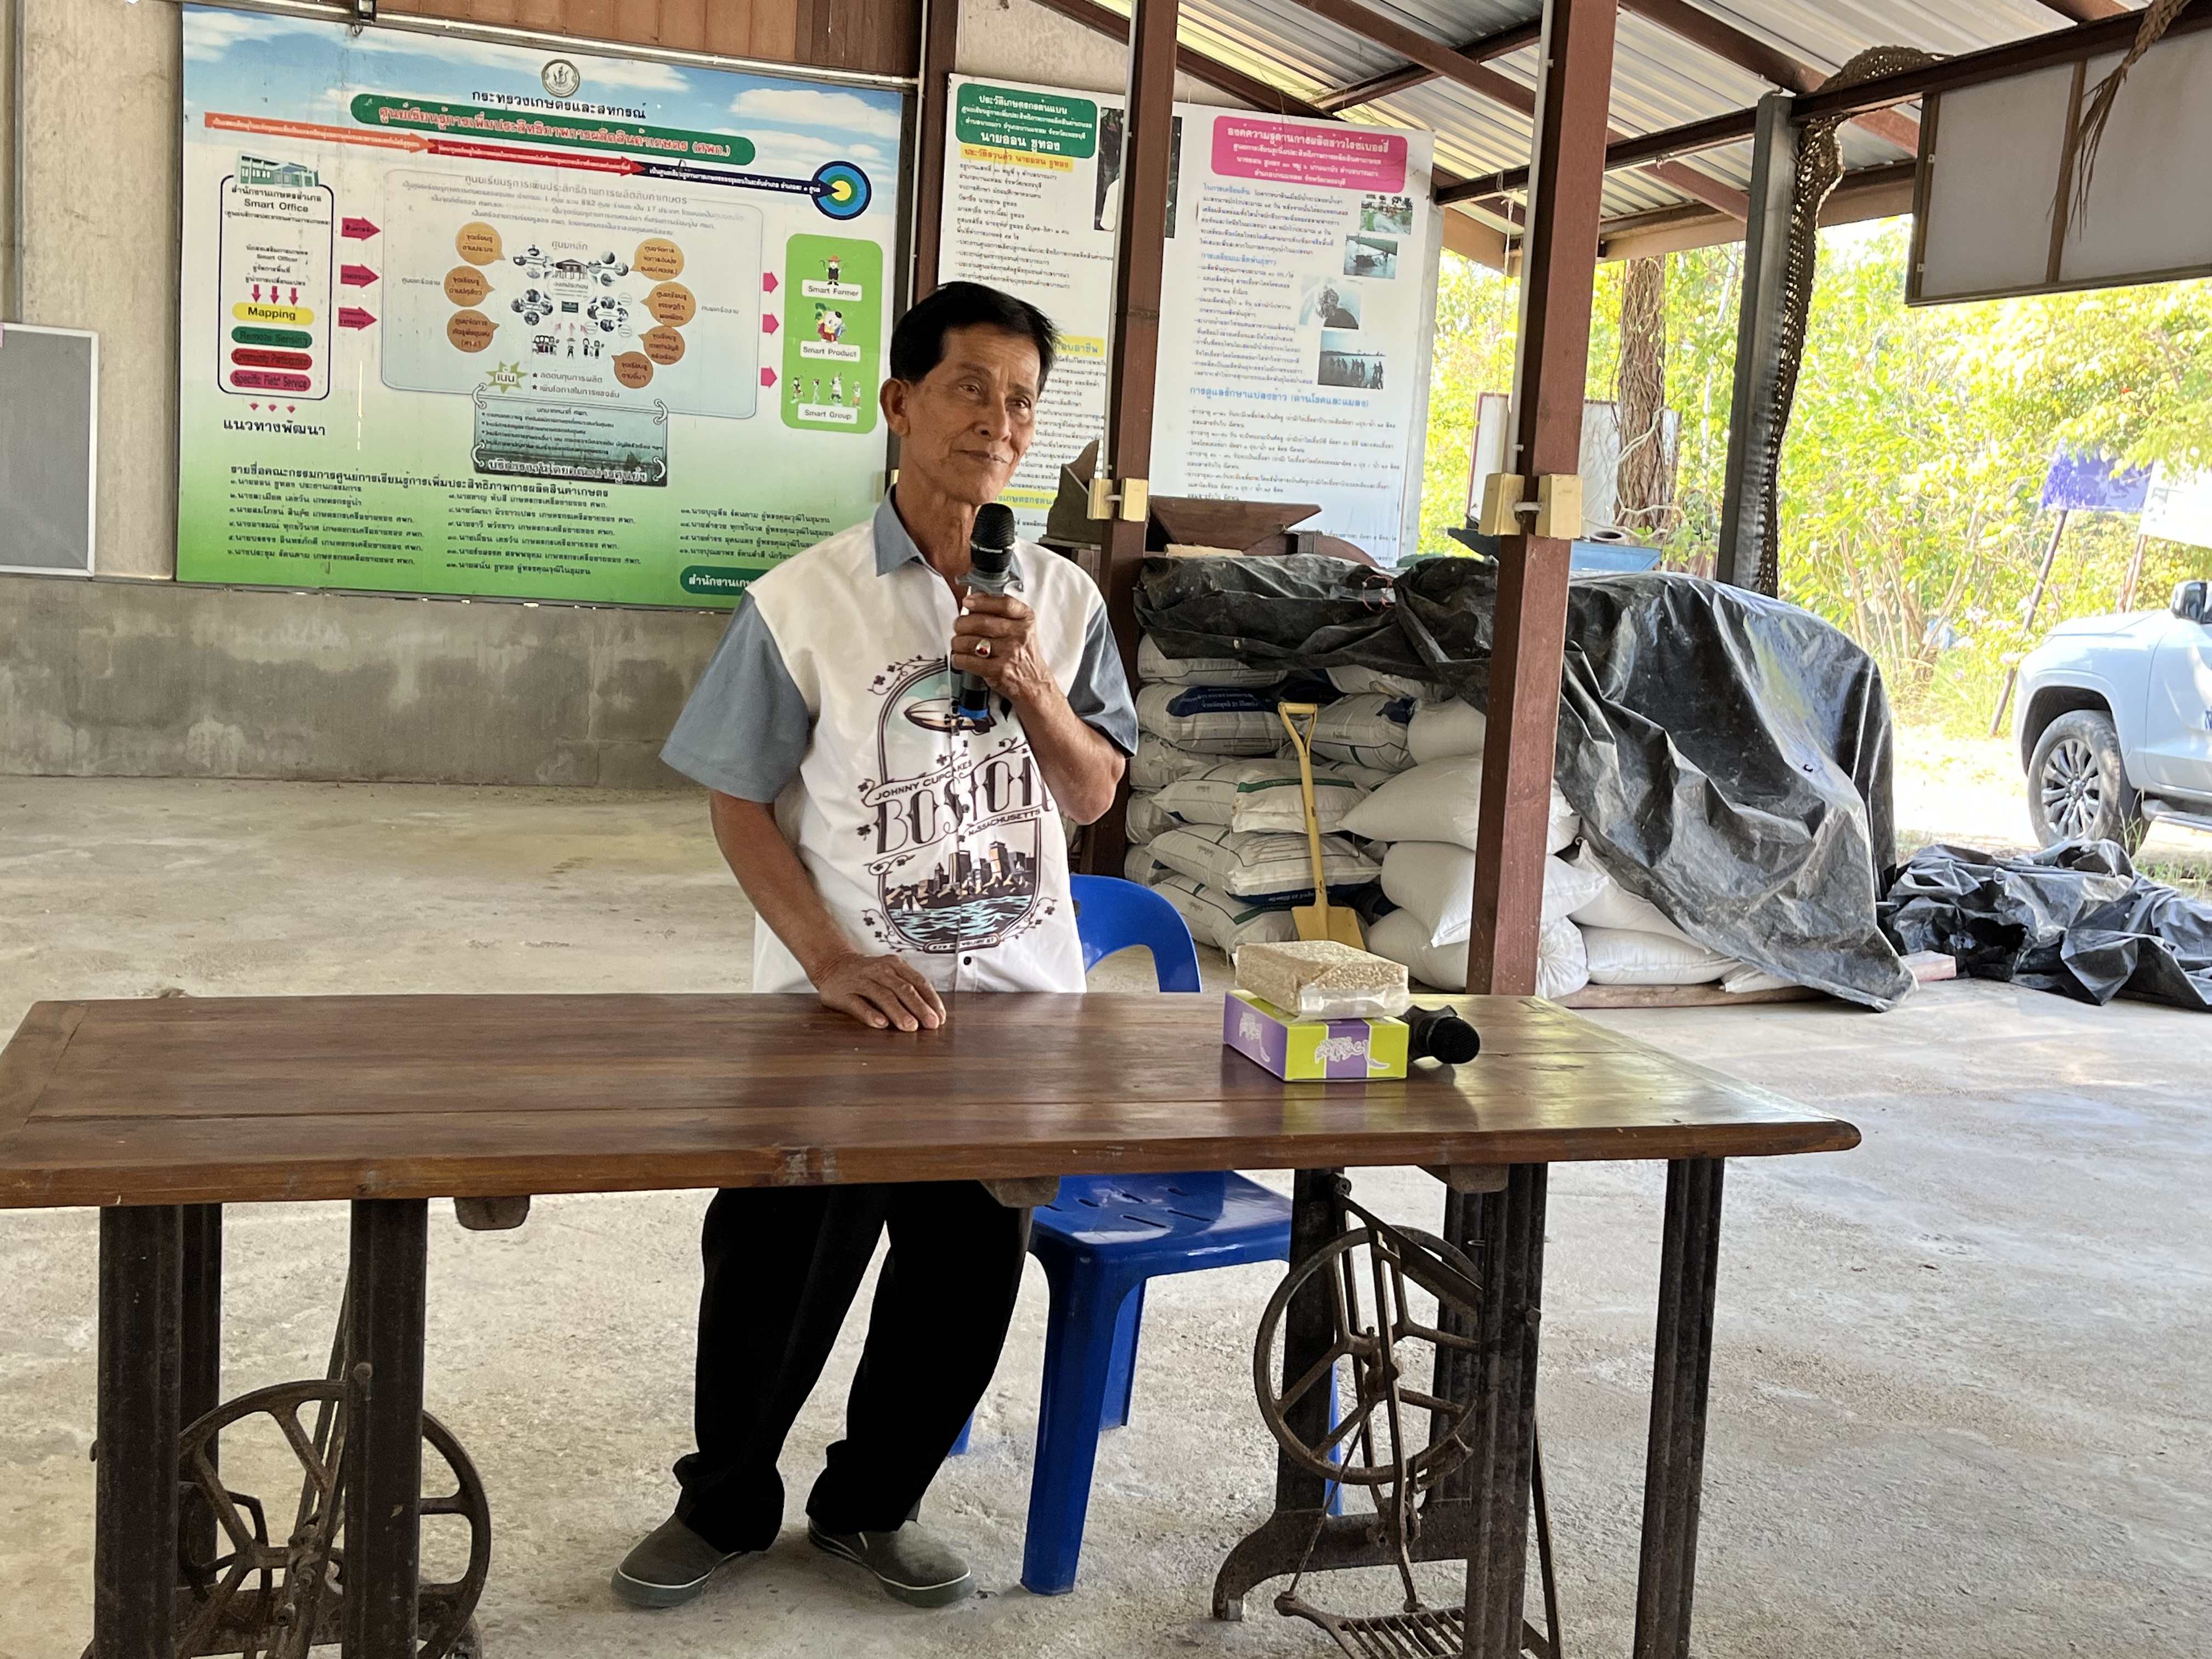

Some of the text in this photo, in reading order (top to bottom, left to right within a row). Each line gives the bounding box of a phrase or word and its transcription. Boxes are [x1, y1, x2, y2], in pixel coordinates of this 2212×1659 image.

[472, 91, 646, 119] กระทรวงเกษตรและสหกรณ์
[379, 101, 689, 152] ศูนย์เรียนรู้การเพิ่มประสิทธิภาพการผลิตสินค้าเกษตร
[692, 140, 731, 157] (ศพก.)
[1030, 136, 1061, 153] ชูทอง
[232, 184, 321, 202] สำนักงานเกษตรอำเภอ
[244, 198, 309, 212] Smart Office
[808, 285, 859, 297] Smart Farmer
[247, 307, 296, 321] Mapping
[803, 346, 857, 358] Smart Product
[829, 411, 852, 420] Group
[223, 419, 325, 436] แนวทางพัฒนา
[874, 781, 919, 800] JOHNNY
